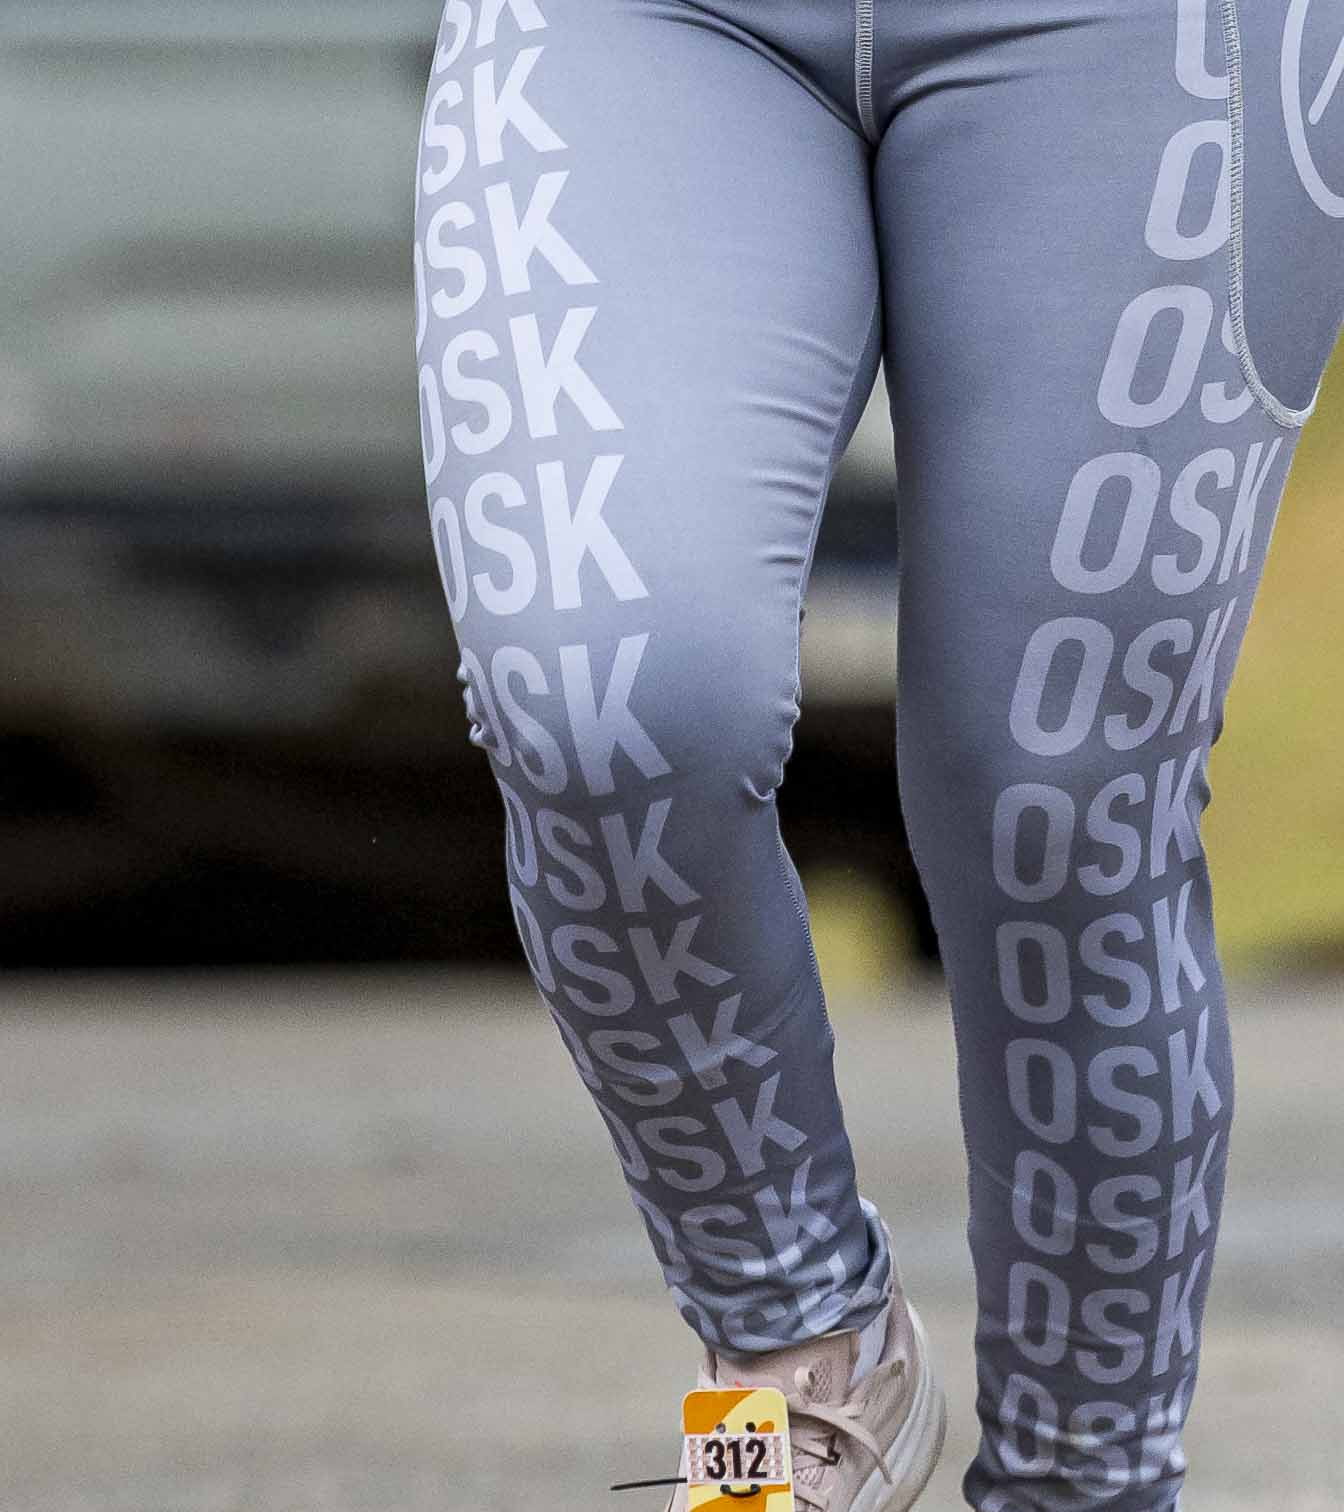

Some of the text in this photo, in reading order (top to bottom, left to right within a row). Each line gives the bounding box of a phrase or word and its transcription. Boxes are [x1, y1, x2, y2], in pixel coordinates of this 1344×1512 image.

[422, 45, 568, 195] SK
[431, 453, 650, 624] OSK
[1050, 436, 1284, 596] OSK
[1009, 596, 1238, 758] OSK
[497, 778, 704, 913] OSK
[992, 746, 1203, 904] OSK
[995, 879, 1207, 1027] OSK
[1006, 1007, 1224, 1158] OSK
[1011, 1129, 1221, 1274] OSK
[1007, 1249, 1206, 1384] OSK
[705, 1439, 768, 1480] 312
